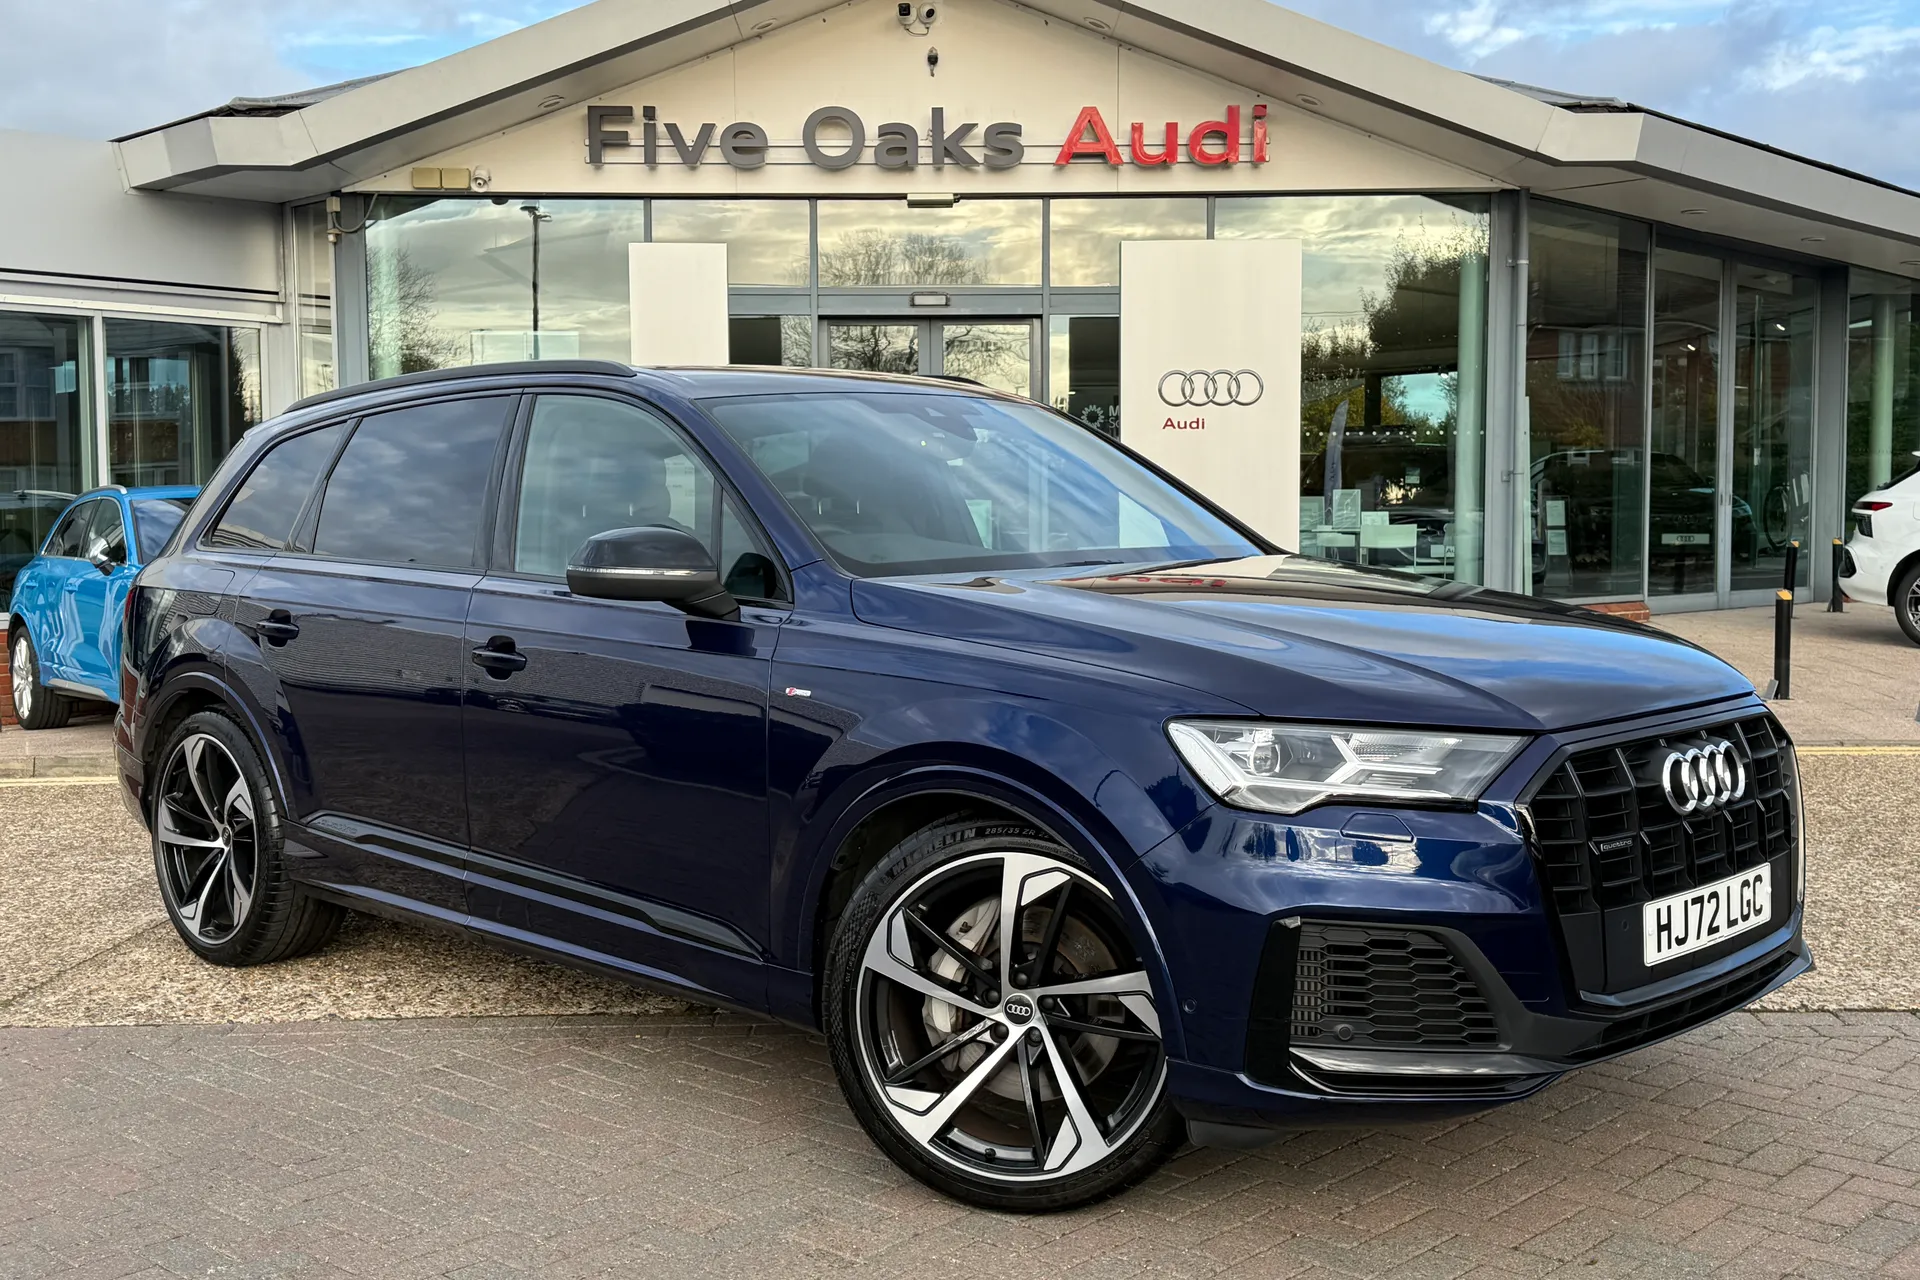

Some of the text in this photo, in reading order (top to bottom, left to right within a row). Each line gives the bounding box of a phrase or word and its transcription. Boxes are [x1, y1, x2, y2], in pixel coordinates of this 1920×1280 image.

[587, 103, 1268, 169] Five Oaks Audi
[1162, 417, 1206, 430] Audi
[985, 827, 1020, 835] 285/35
[1656, 873, 1763, 954] HJ72 LGC
